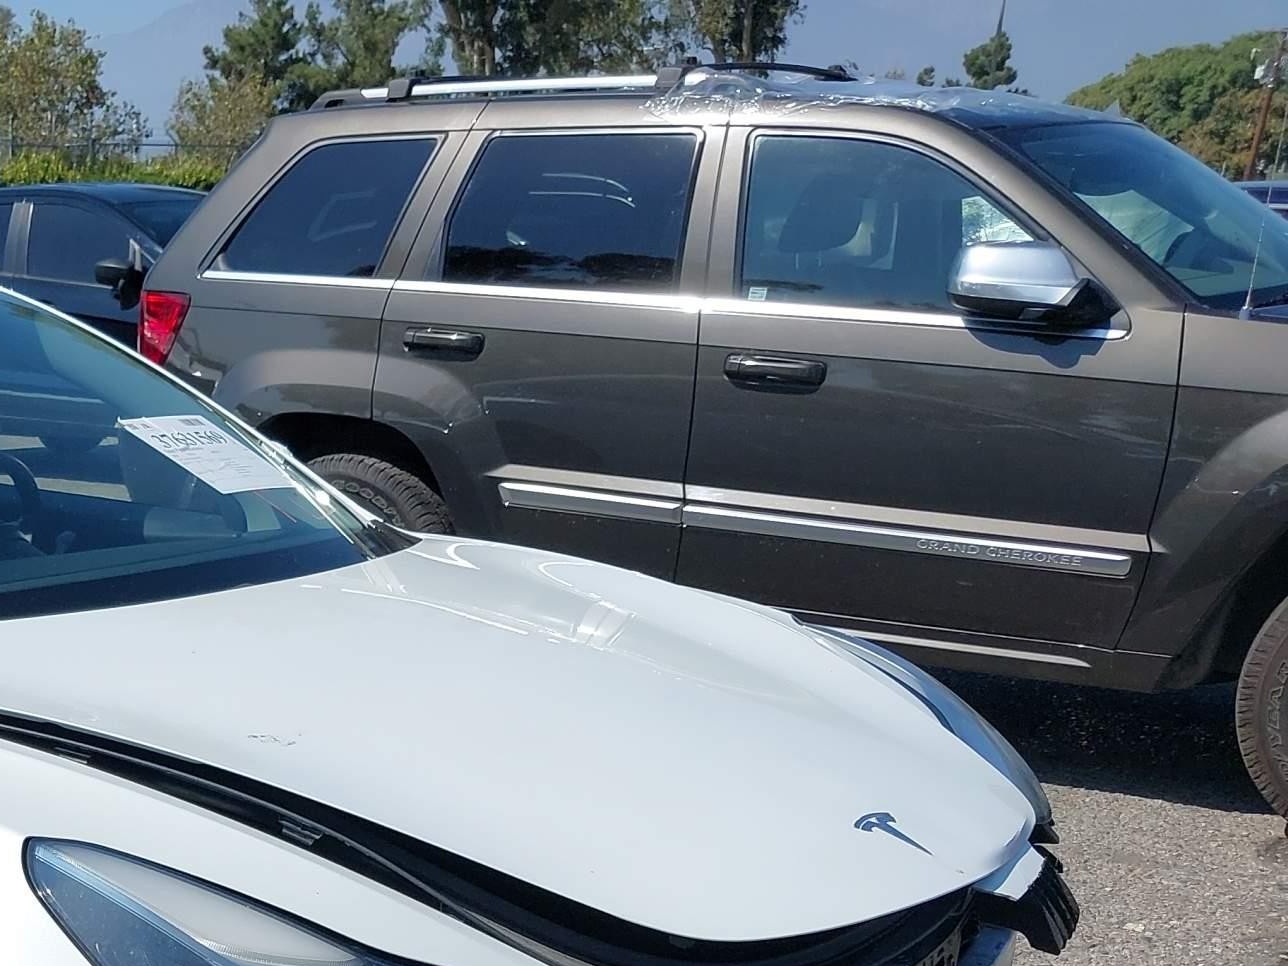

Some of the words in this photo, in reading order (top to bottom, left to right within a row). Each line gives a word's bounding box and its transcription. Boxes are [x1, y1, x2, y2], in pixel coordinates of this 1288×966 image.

[151, 430, 228, 449] 37631569
[915, 538, 980, 555] GRAND
[985, 546, 1084, 566] CHEROKEE
